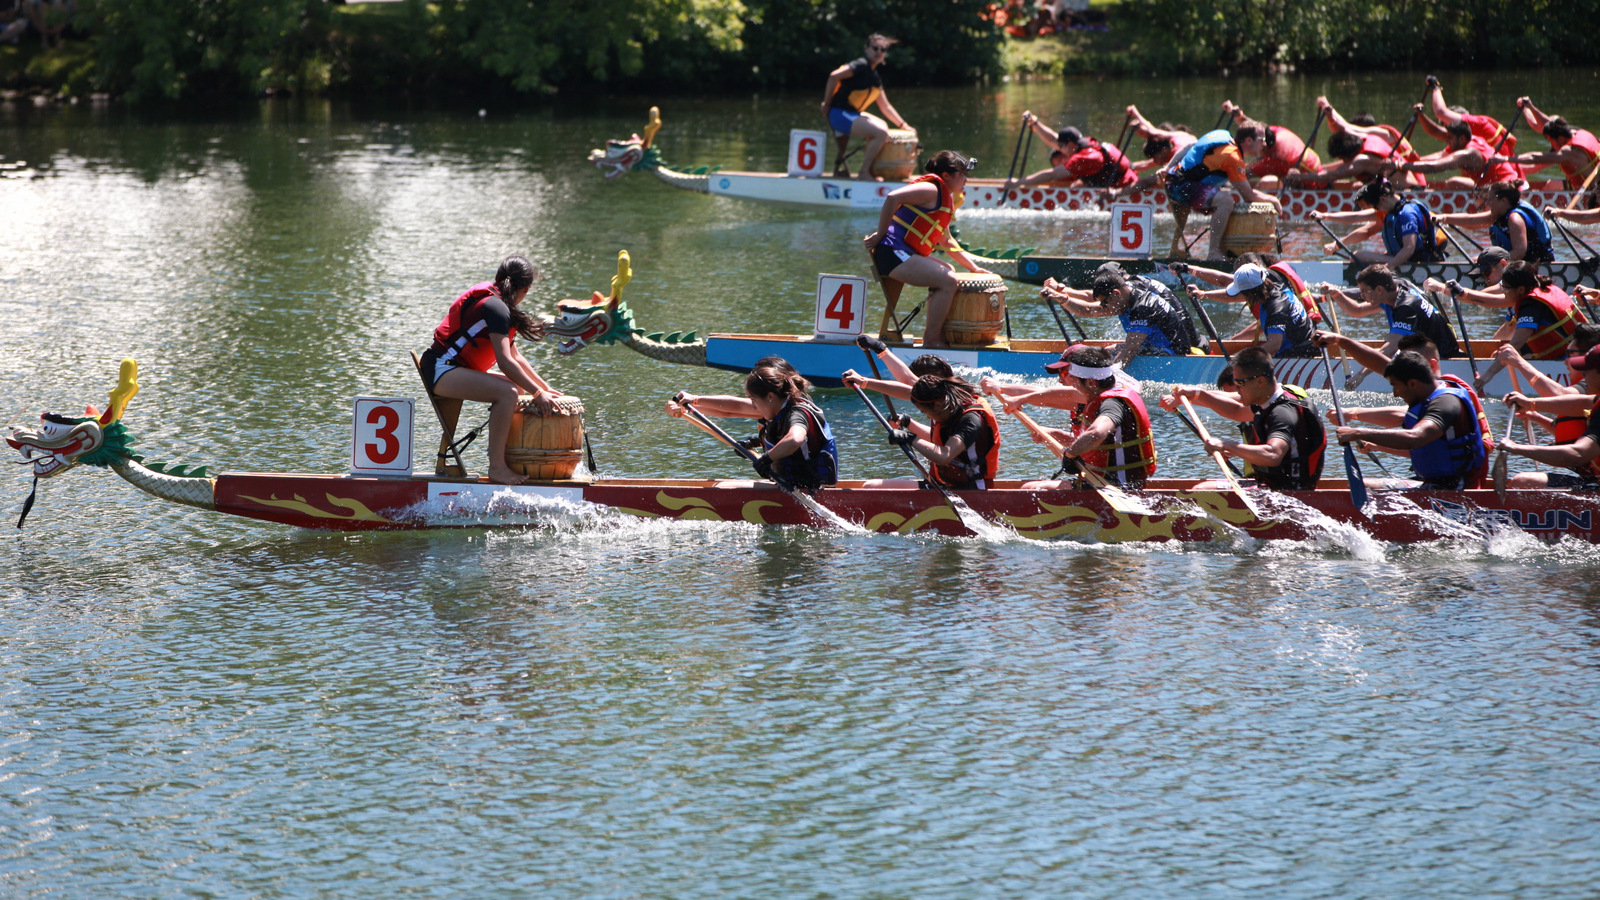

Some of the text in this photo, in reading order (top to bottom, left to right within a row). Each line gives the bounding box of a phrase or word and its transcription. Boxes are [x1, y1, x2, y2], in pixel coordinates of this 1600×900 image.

[798, 138, 816, 170] 6
[1120, 210, 1143, 250] 5
[825, 284, 854, 329] 4
[365, 406, 400, 464] 3
